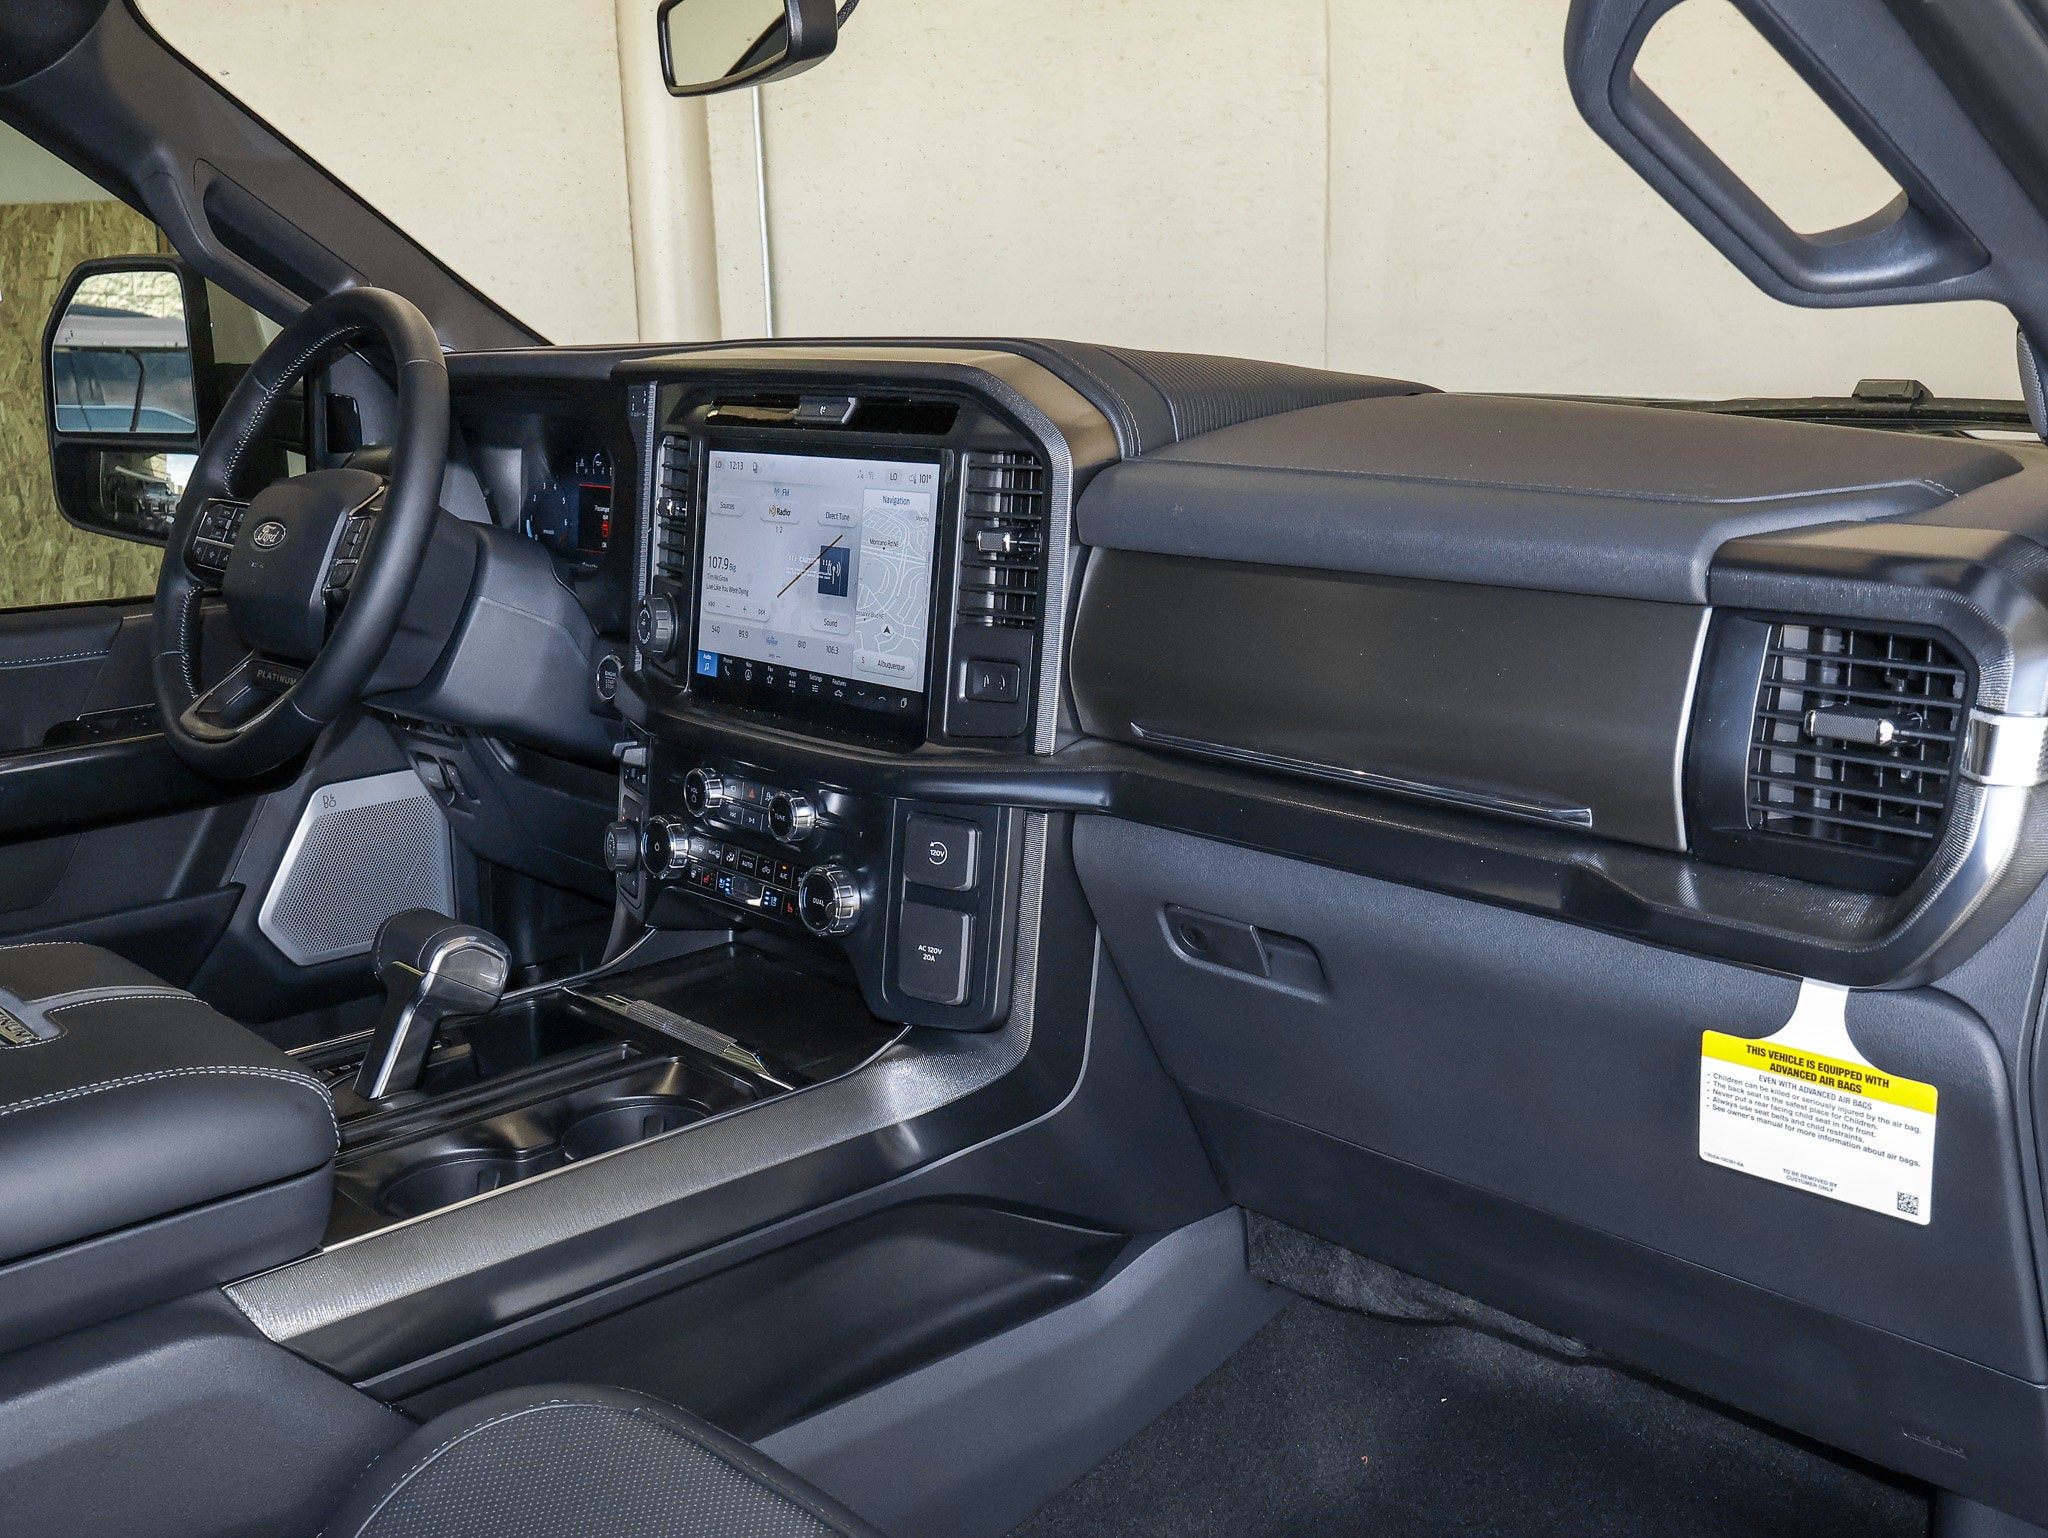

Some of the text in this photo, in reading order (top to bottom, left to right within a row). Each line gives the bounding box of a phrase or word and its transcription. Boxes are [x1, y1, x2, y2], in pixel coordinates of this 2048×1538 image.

[729, 461, 744, 470] 12:13
[890, 472, 898, 481] LO
[882, 495, 911, 506] Navigation
[825, 511, 850, 522] Direct Tune
[708, 556, 729, 570] 107.9
[824, 618, 838, 628] Sound
[826, 645, 839, 655] 106.3
[878, 660, 906, 672] Albuquerque
[256, 669, 298, 686] PLATINUM
[774, 812, 786, 822] TUNE
[930, 849, 946, 858] 120V
[742, 860, 754, 869] AUTO
[812, 897, 825, 907] DUAL
[918, 944, 943, 956] AC 120V
[922, 953, 936, 962] 20A
[1746, 1044, 1890, 1088] THIS VEHICLE IS EQUIPPED WITH
[1770, 1062, 1862, 1094] ADVANCED AIR BAGS
[1758, 1074, 1872, 1110] EVEN WITH ADVANCED AIR BAGS
[1713, 1072, 1743, 1085] Children
[1760, 1083, 1768, 1092] be
[1770, 1088, 1790, 1098] killed
[1802, 1097, 1836, 1111] seriously
[1838, 1105, 1864, 1118] injured
[1866, 1113, 1876, 1122] by
[1878, 1116, 1890, 1125] the
[1892, 1120, 1903, 1128] air
[1904, 1123, 1922, 1134] bag.
[1713, 1081, 1726, 1090] The
[1728, 1085, 1744, 1094] back
[1747, 1090, 1762, 1099] seat
[1772, 1096, 1783, 1105] the
[1785, 1100, 1807, 1111] safest
[1809, 1107, 1829, 1117] place
[1831, 1111, 1842, 1119] for
[1844, 1115, 1878, 1130] Children.
[1712, 1088, 1733, 1098] Never
[1735, 1095, 1747, 1103] put
[1755, 1101, 1769, 1109] rear
[1770, 1104, 1793, 1116] facing
[1795, 1110, 1813, 1120] child
[1815, 1116, 1831, 1126] seat
[1842, 1122, 1854, 1131] the
[1856, 1126, 1876, 1138] front.
[1712, 1097, 1738, 1108] Always
[1754, 1108, 1770, 1116] seat
[1771, 1112, 1789, 1122] belts
[1791, 1117, 1804, 1126] and
[1807, 1122, 1824, 1132] child
[1826, 1128, 1864, 1143] restraints.
[1712, 1104, 1726, 1113] See
[1727, 1109, 1754, 1120] owner's
[1756, 1117, 1783, 1128] manual
[1784, 1124, 1795, 1132] for
[1796, 1128, 1816, 1138] more
[1818, 1133, 1861, 1150] information
[1862, 1146, 1885, 1157] about
[1899, 1155, 1921, 1167] bags.
[1786, 1175, 1817, 1188] CUSTOMER
[1800, 1173, 1829, 1186] REMOVED
